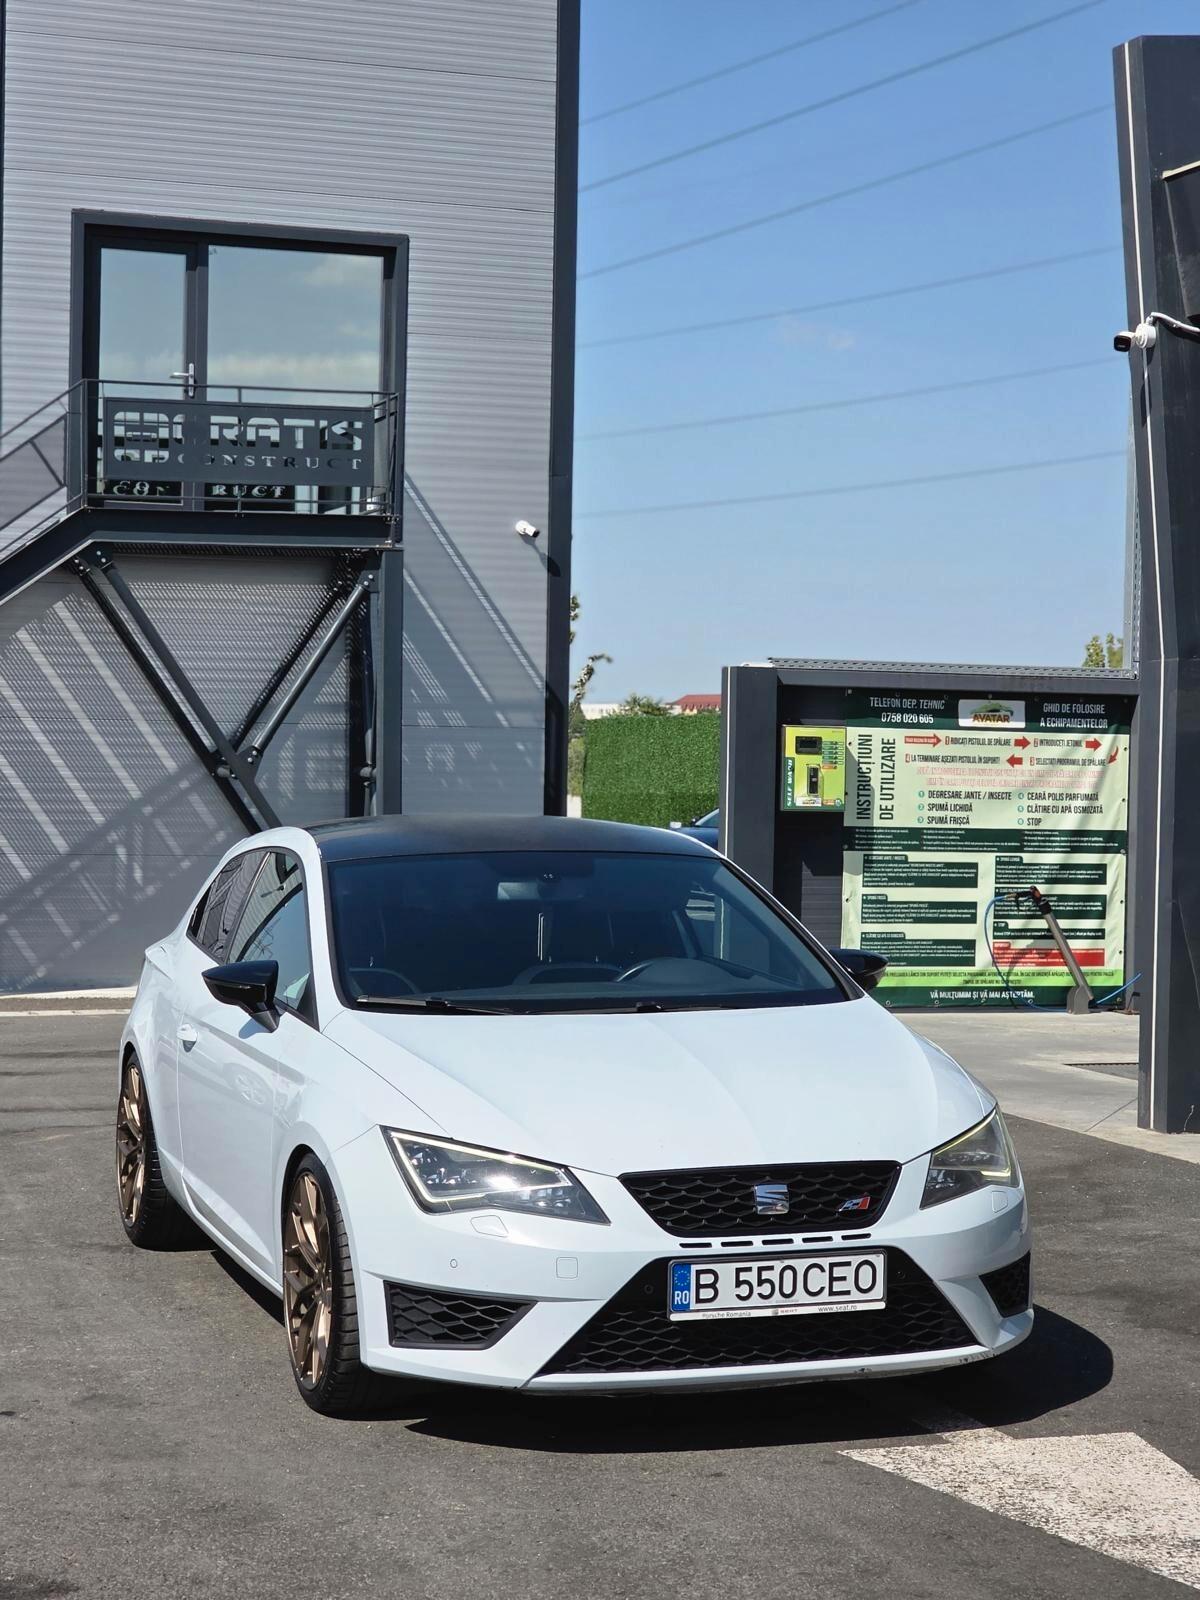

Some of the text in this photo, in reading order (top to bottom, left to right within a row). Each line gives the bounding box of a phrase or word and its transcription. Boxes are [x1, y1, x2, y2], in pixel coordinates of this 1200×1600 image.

[870, 697, 945, 710] TELEFON DEP. TEHNIC
[1043, 703, 1105, 714] GHID DE FOLOSIRE
[881, 712, 934, 724] 0758 020 605
[972, 713, 1010, 723] AVATAR
[1040, 718, 1108, 729] A ECHIPAMENTELOR
[880, 738, 896, 820] DE UTILIZARE
[928, 790, 962, 799] DEGRESARE
[963, 791, 981, 800] JANTE
[988, 791, 1012, 801] INSECTE
[1047, 792, 1064, 801] POLIS
[927, 803, 949, 812] SPUMĂ
[949, 803, 973, 812] LICHIDĂ
[1052, 805, 1060, 814] CU
[1061, 804, 1072, 814] APĂ
[927, 816, 948, 825] SPUMĂ
[1027, 818, 1042, 826] STOP
[930, 990, 939, 998] VĂ
[979, 989, 988, 999] VĂ
[989, 990, 1000, 998] MAI
[695, 1268, 719, 1304] B
[674, 1290, 690, 1305] RO
[818, 1303, 858, 1312] www.seat.ro
[726, 1310, 751, 1318] Romania
